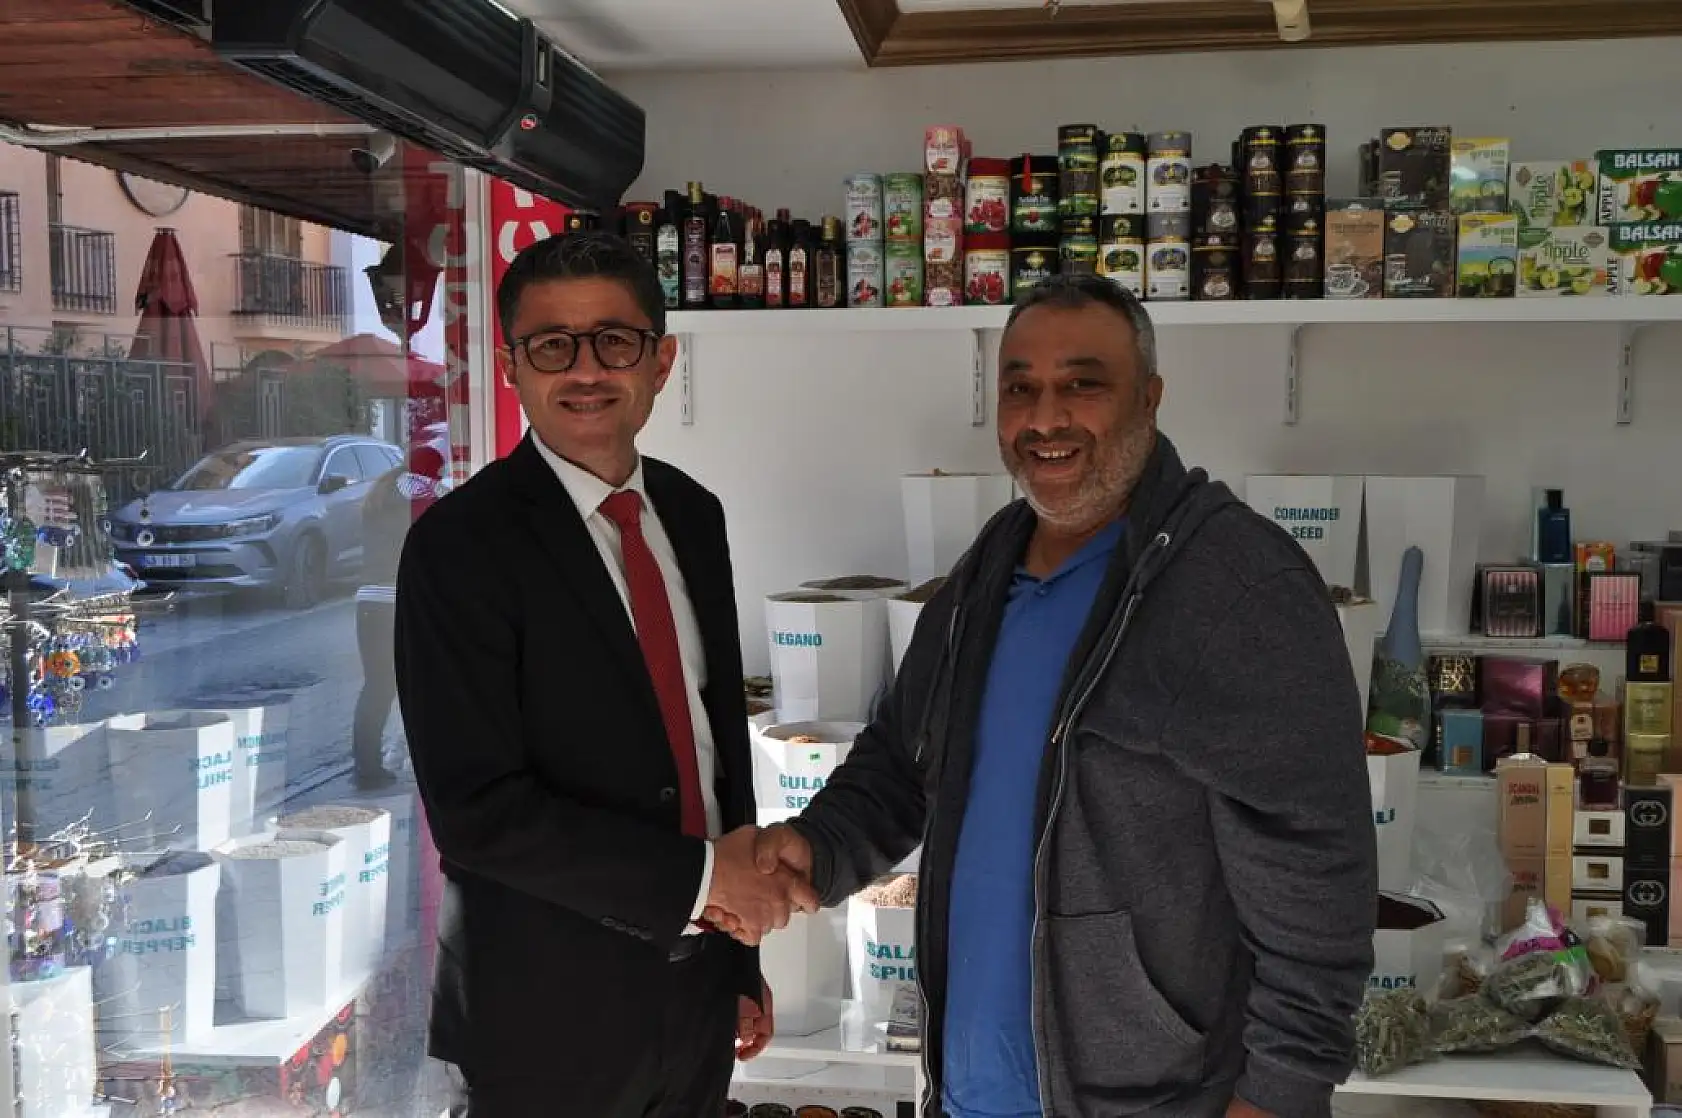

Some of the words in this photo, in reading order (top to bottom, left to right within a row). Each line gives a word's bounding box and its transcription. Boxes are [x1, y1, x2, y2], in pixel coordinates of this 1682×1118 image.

[1614, 152, 1680, 168] BALSAM
[1291, 526, 1324, 539] SEED
[773, 631, 822, 646] EGANO
[778, 774, 826, 790] GULA
[866, 940, 917, 960] SALA
